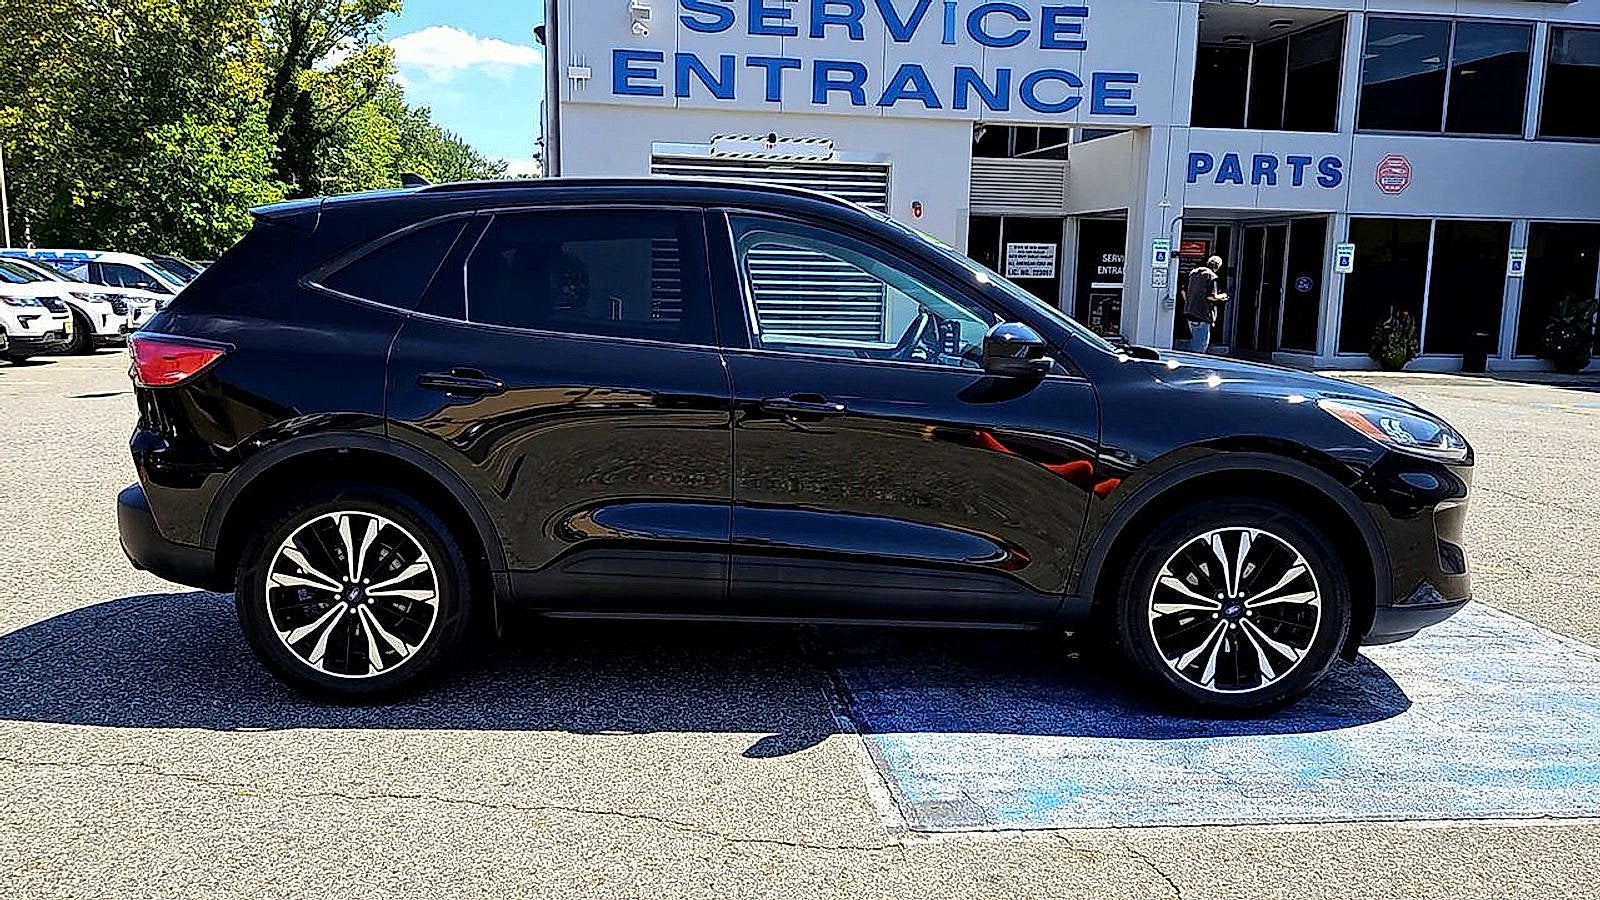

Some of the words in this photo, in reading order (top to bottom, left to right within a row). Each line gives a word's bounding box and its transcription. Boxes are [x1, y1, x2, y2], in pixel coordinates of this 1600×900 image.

[680, 0, 1088, 50] SERVICE
[613, 49, 1139, 115] ENTRANCE
[1186, 152, 1344, 188] PARTS
